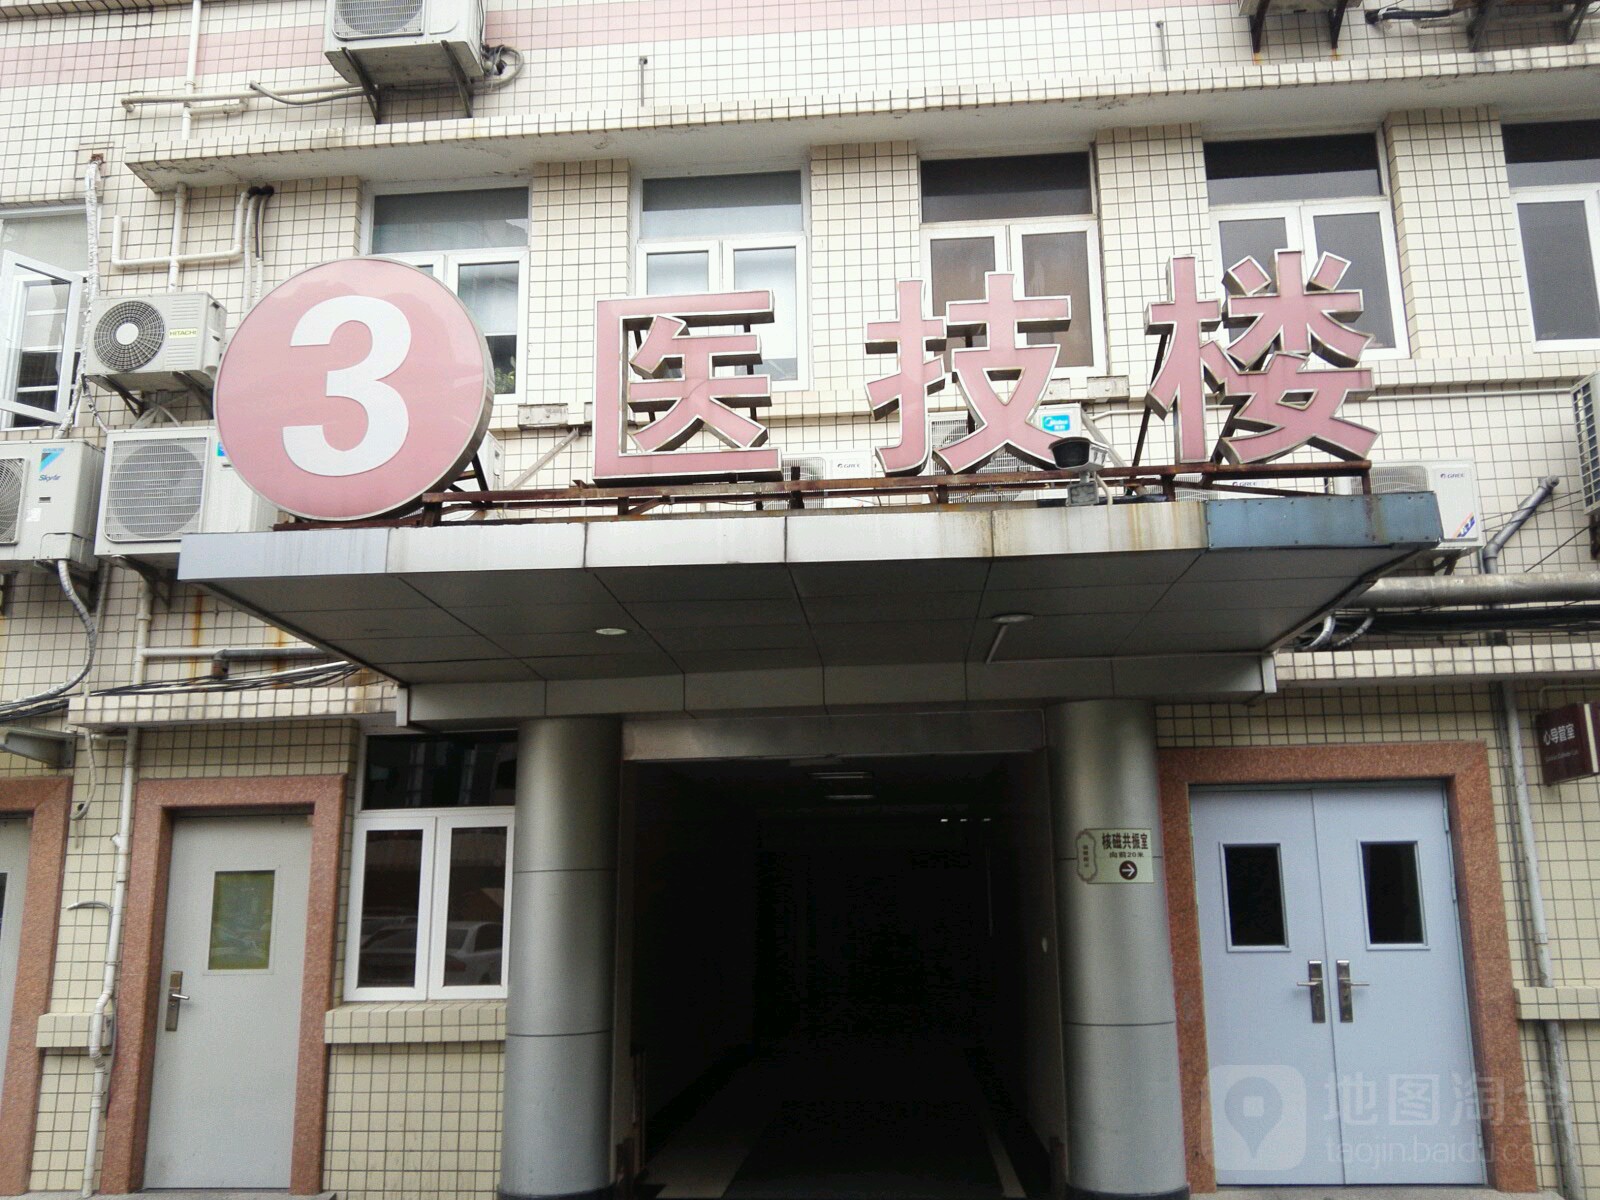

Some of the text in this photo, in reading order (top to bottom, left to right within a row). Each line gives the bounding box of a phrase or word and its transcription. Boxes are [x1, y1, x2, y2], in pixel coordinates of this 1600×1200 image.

[282, 295, 412, 477] 3
[595, 248, 1379, 480] 医技楼
[1102, 832, 1149, 850] 核磁共振室
